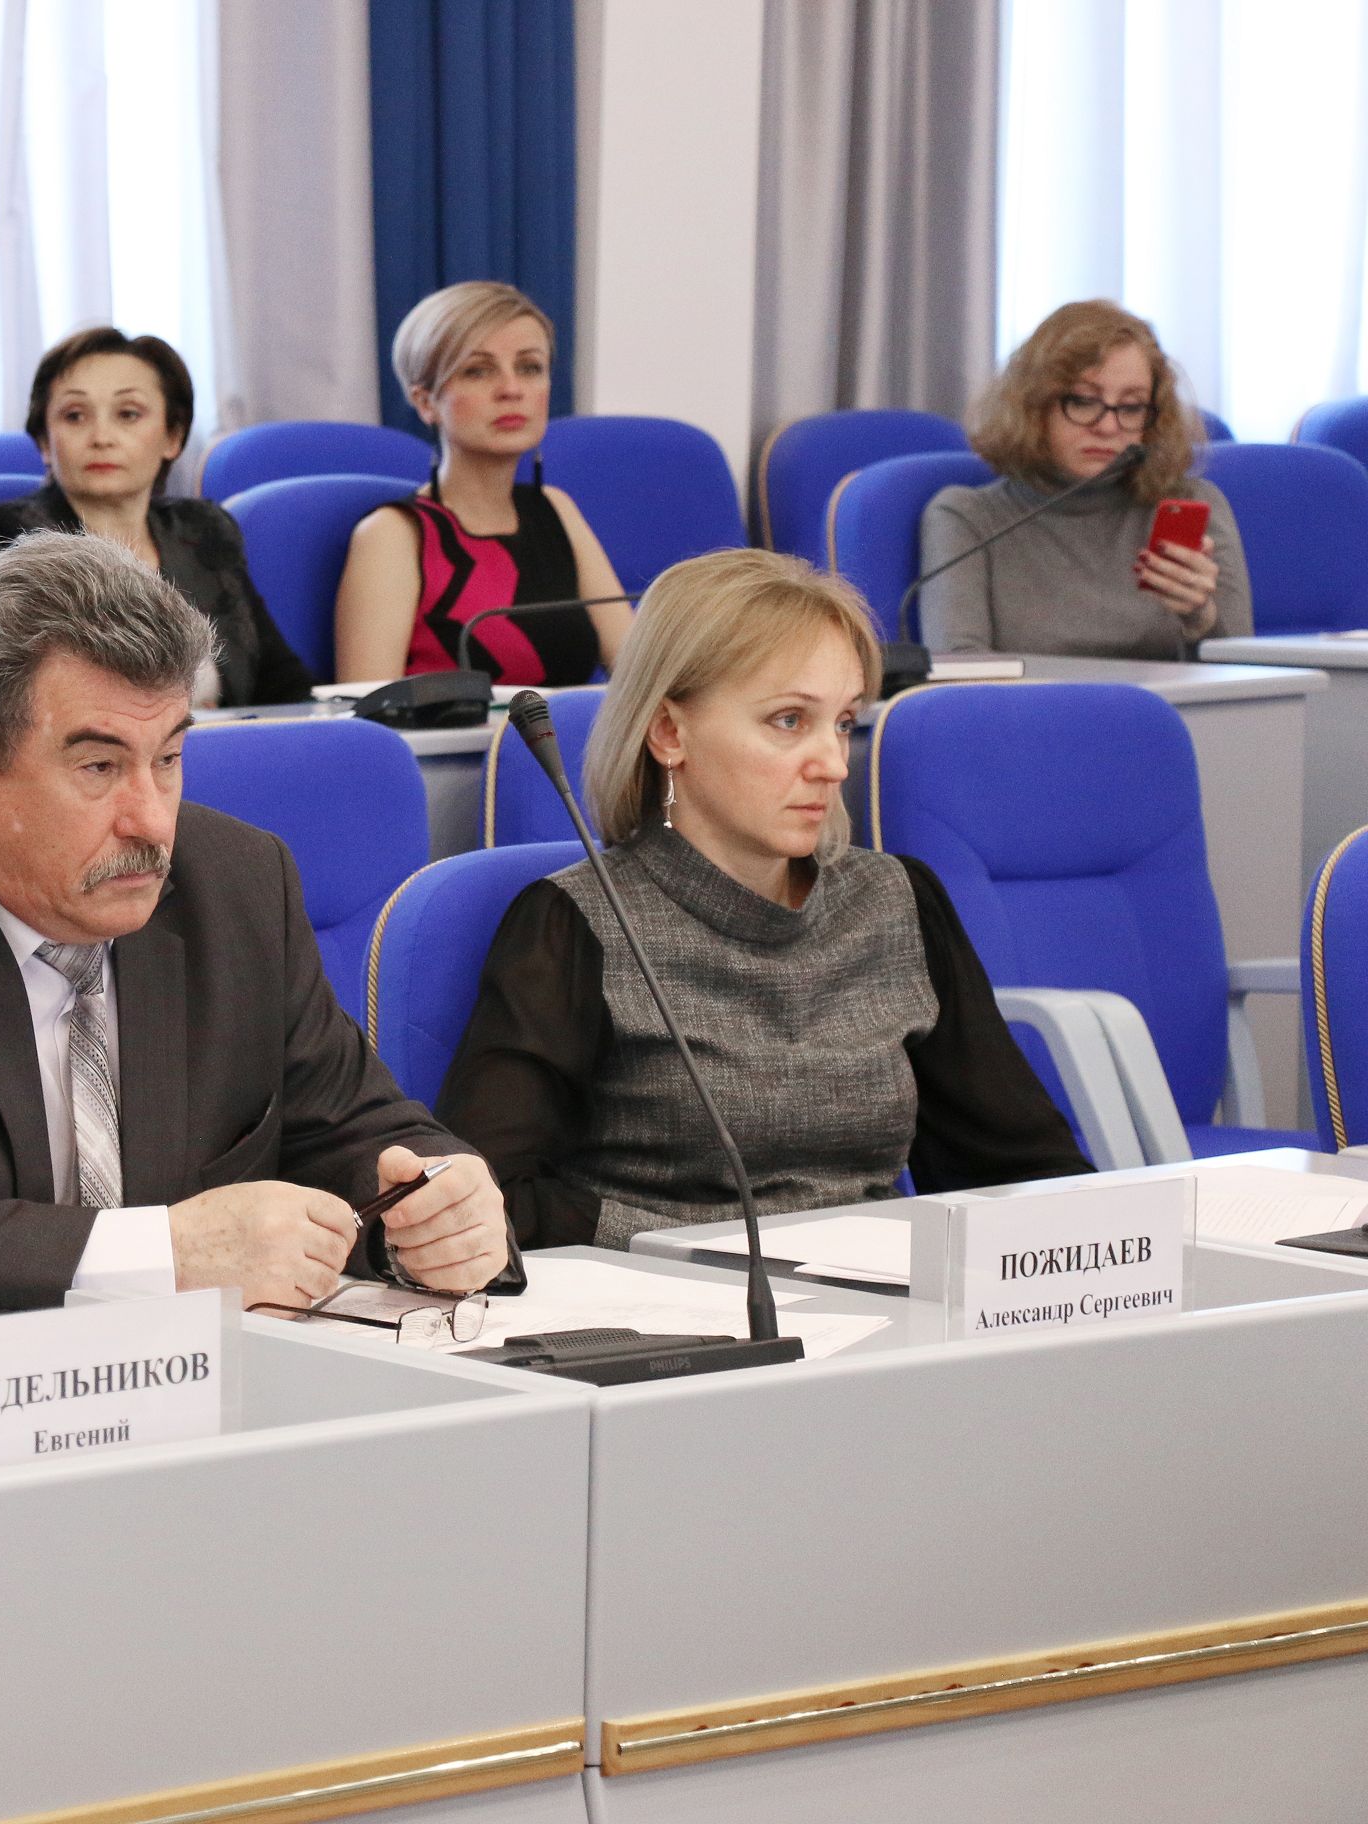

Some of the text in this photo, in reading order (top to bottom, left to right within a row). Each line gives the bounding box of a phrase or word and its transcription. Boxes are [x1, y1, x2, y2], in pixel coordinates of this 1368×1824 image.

[999, 1236, 1153, 1281] ПОЖИДАЕВ
[975, 1288, 1173, 1330] Александр Сергеевич
[33, 1418, 131, 1454] Евгений
